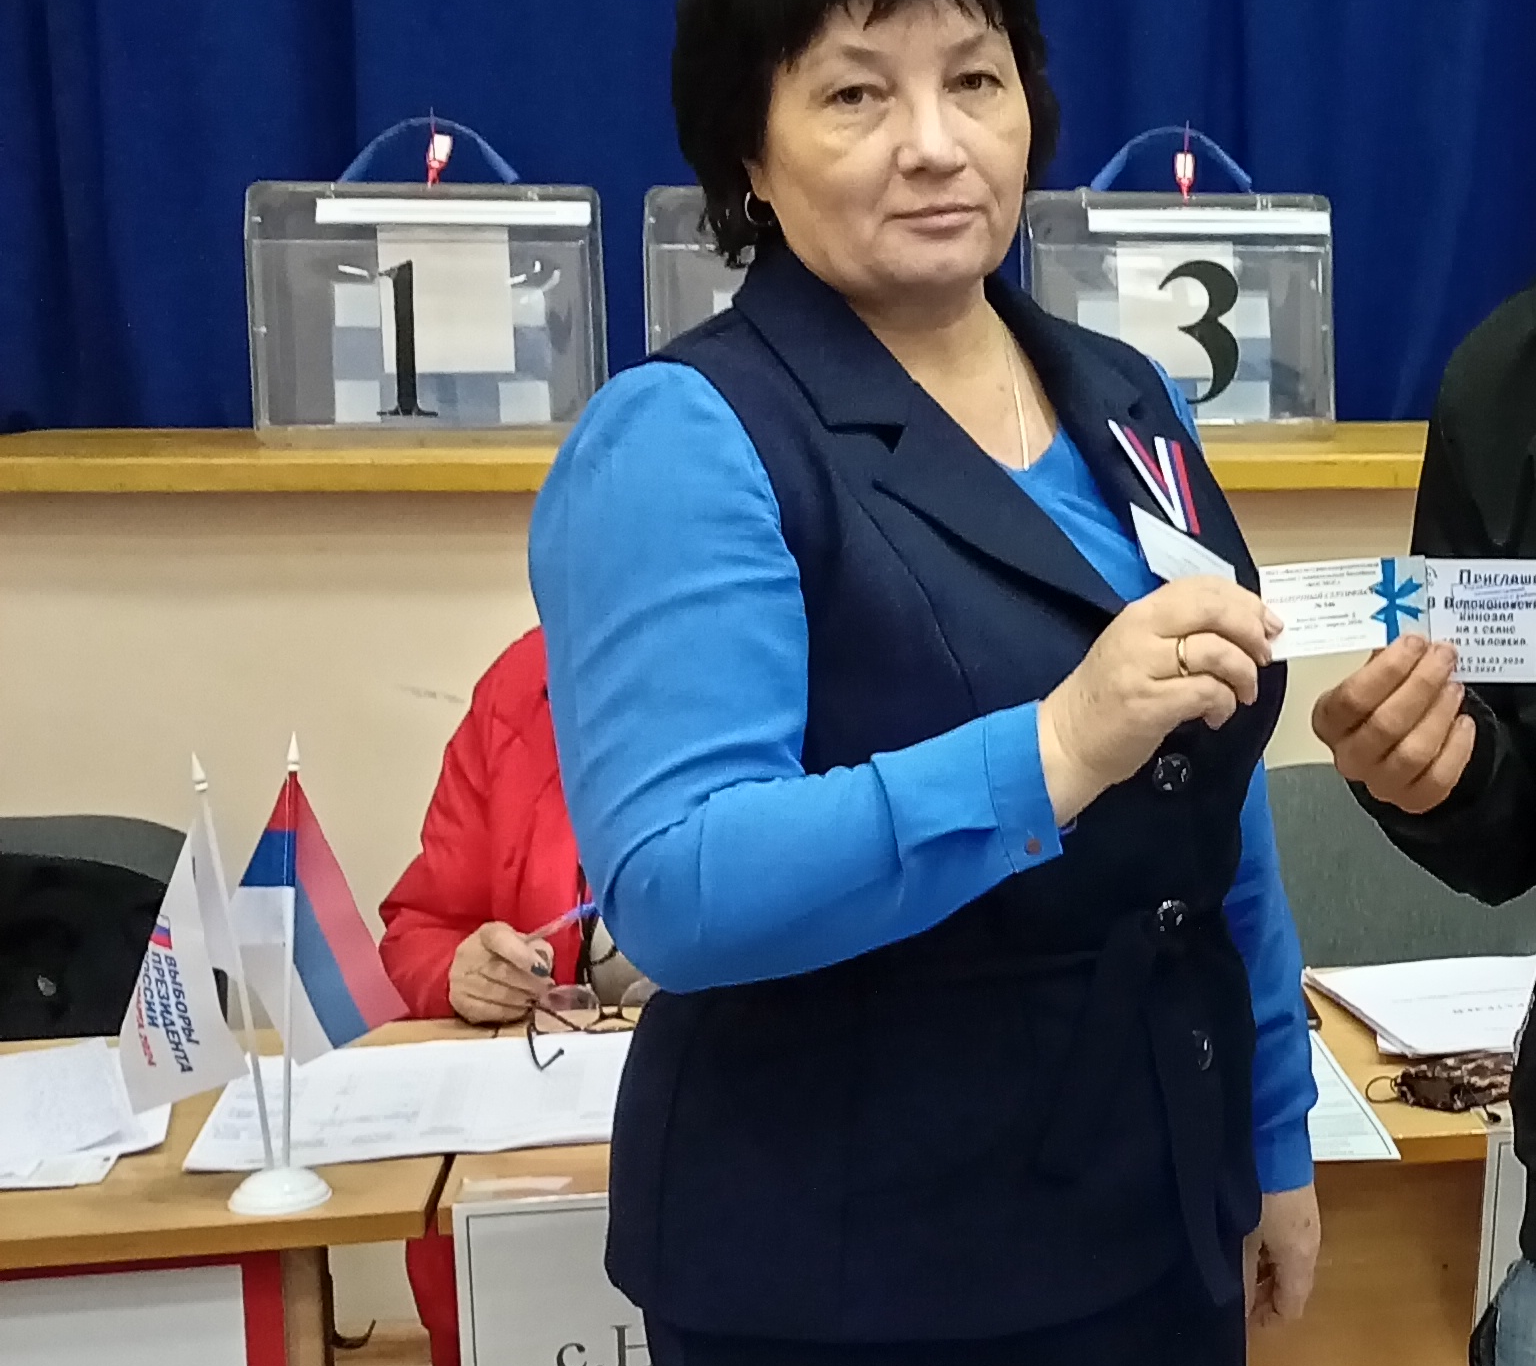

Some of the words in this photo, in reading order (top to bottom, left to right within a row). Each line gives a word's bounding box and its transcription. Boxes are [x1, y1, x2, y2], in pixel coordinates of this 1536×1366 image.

[377, 259, 439, 417] 1
[1158, 259, 1239, 405] 3
[151, 951, 194, 1073] ПРЕЗИДЕНТА
[165, 954, 200, 1045] ВЫБОРЫ
